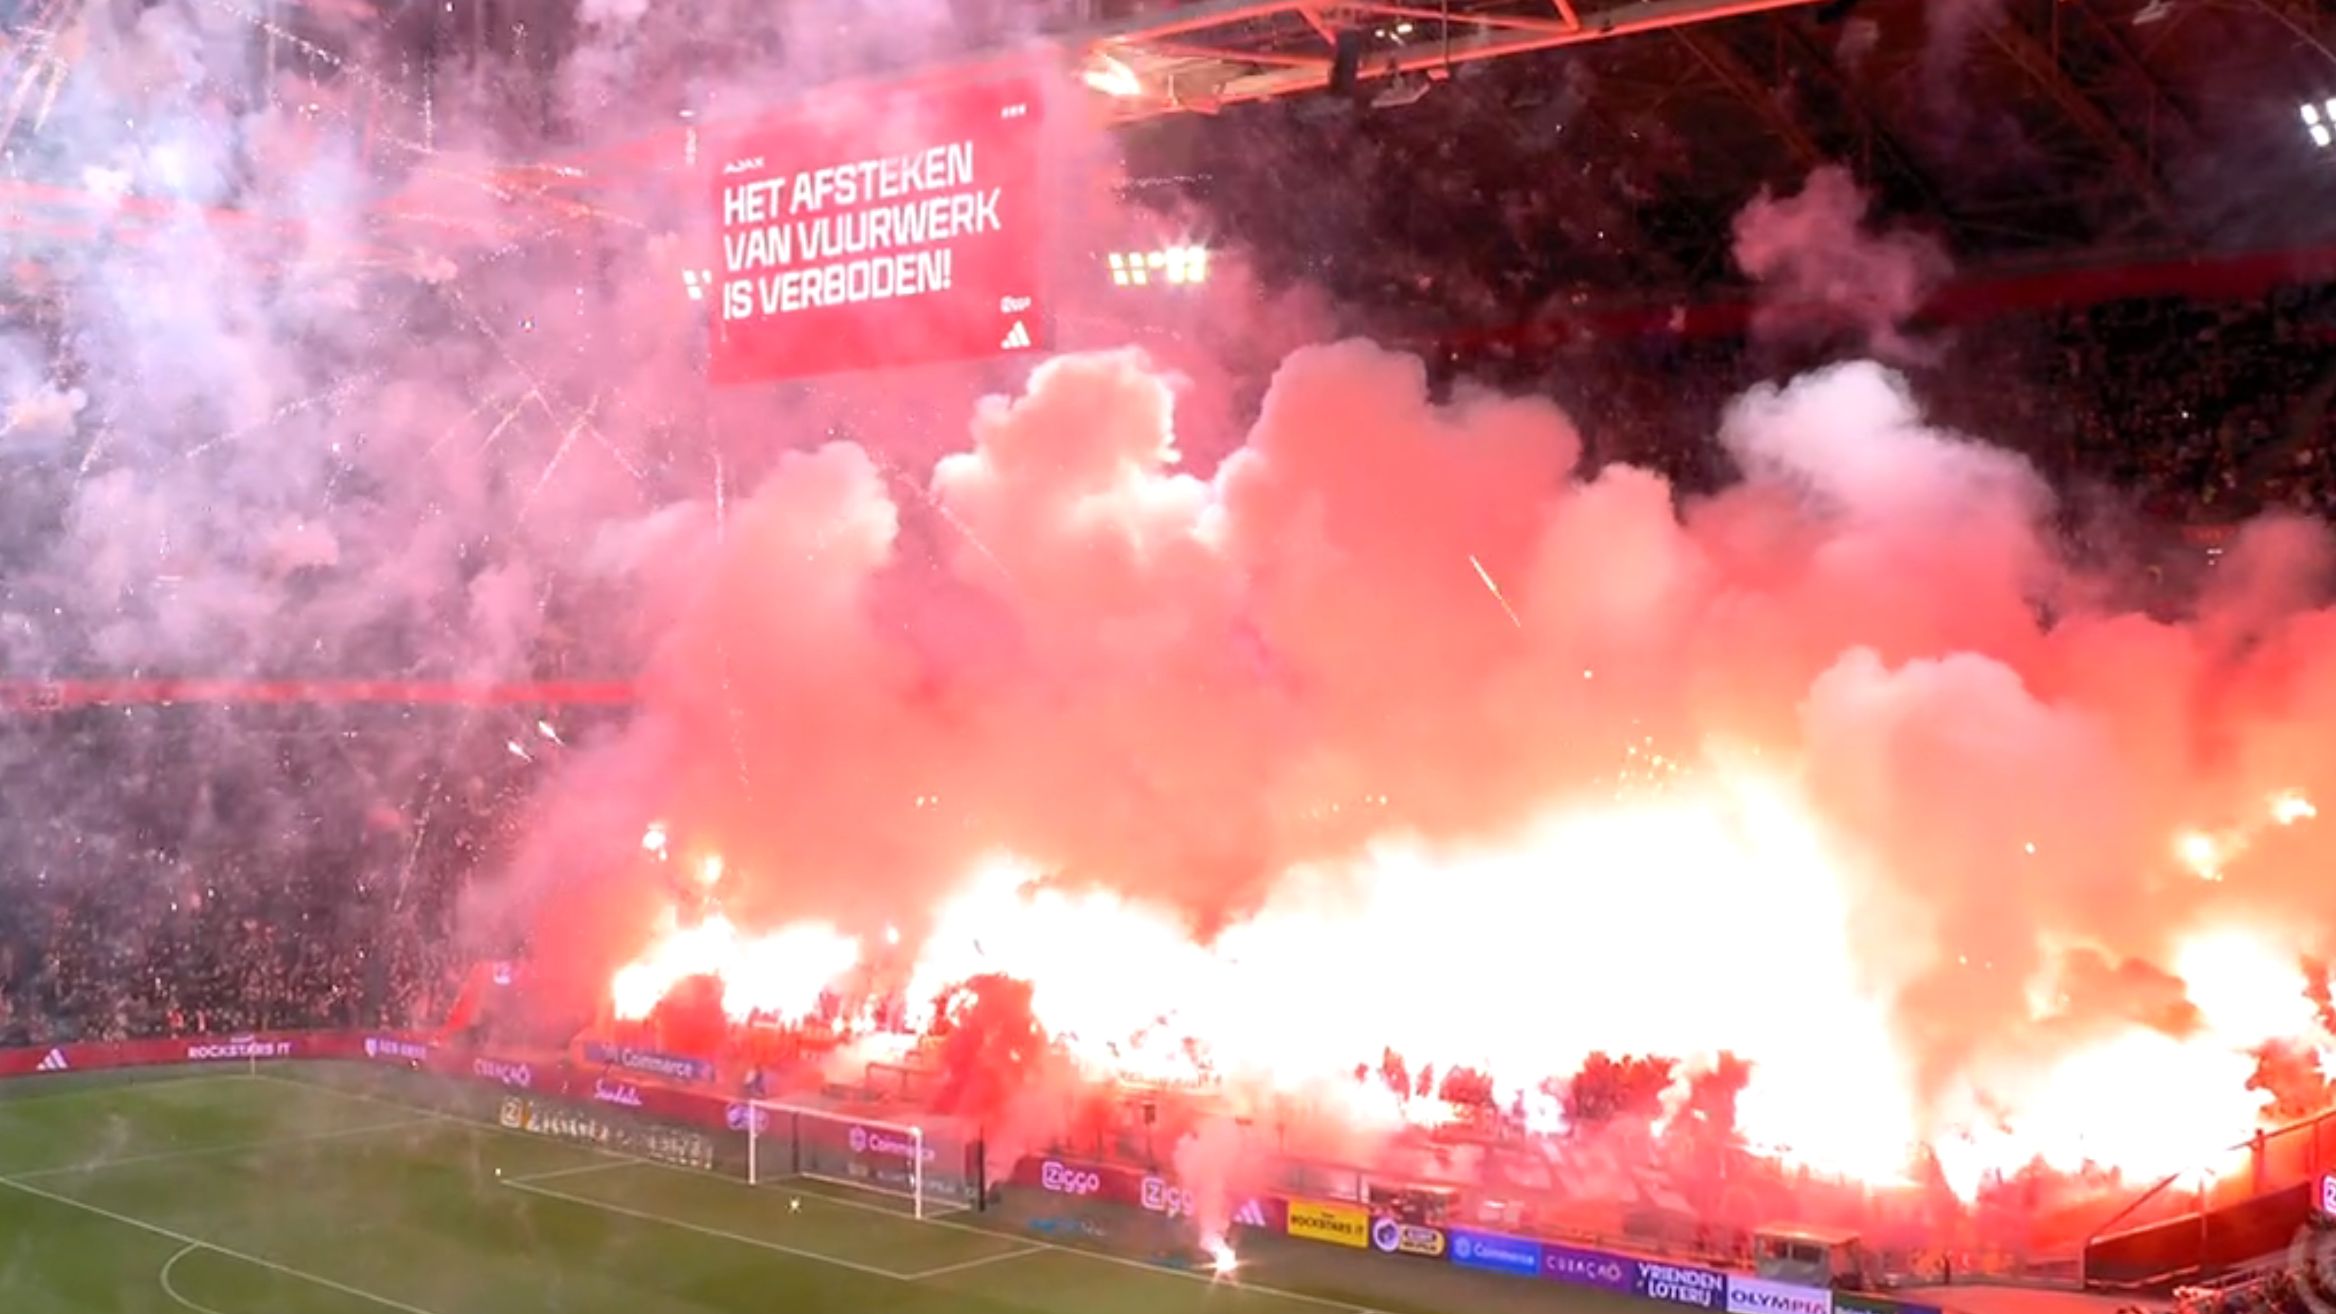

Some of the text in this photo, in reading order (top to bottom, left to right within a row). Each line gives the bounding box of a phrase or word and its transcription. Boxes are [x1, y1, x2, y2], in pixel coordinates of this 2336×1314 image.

[723, 156, 765, 174] AJAX
[724, 141, 973, 226] HET AFSTEKEN
[724, 187, 1001, 271] VAN VUURWERK
[723, 248, 951, 320] IS VERBODEN!
[187, 1041, 291, 1060] ROCKSTARS IT
[621, 1047, 693, 1078] Commerce
[1042, 1160, 1100, 1195] Ziggo
[1141, 1177, 1195, 1217] Zigg
[1637, 1261, 1723, 1291] VRIENDEN
[1648, 1280, 1712, 1308] LOTERIJ
